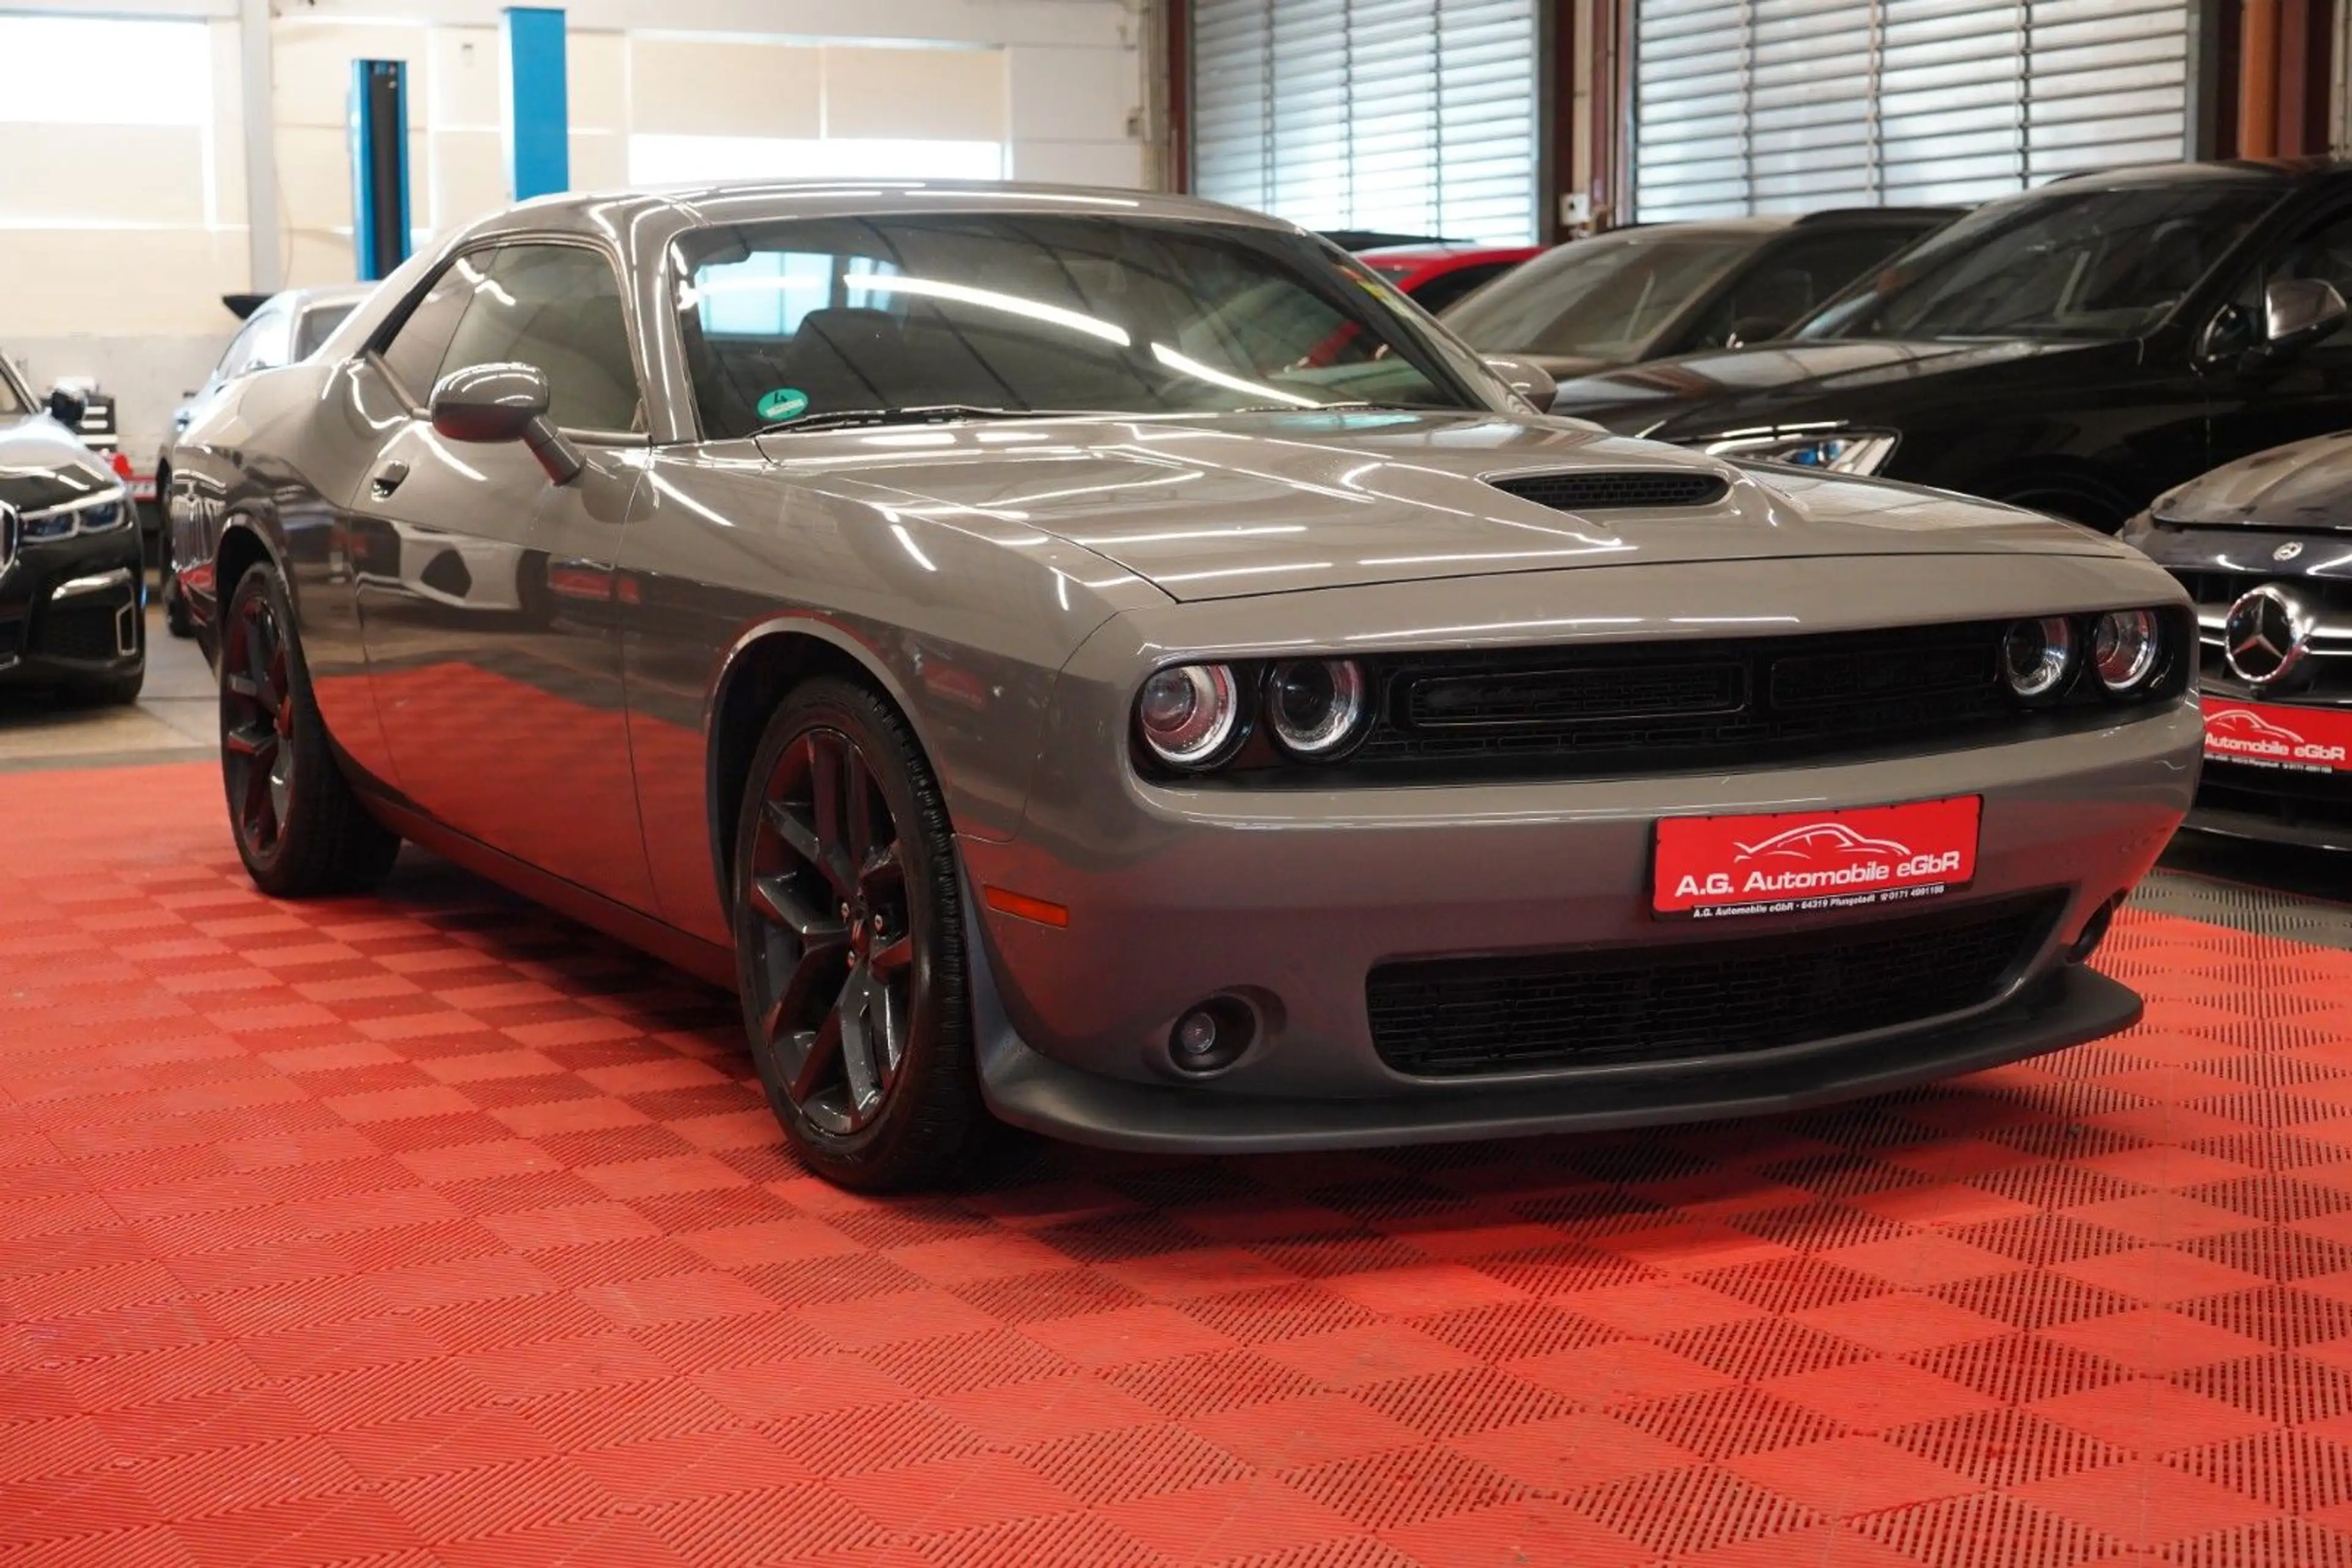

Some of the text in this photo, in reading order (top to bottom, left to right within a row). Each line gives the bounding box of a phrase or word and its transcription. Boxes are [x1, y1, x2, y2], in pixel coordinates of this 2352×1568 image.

[2205, 732, 2345, 761] Automobile eGbR
[1675, 851, 1960, 897] A.G. Automobile eGbR
[1693, 908, 1713, 918] A.G.
[1715, 904, 1767, 917] Automobile
[1769, 902, 1794, 913] eGbR
